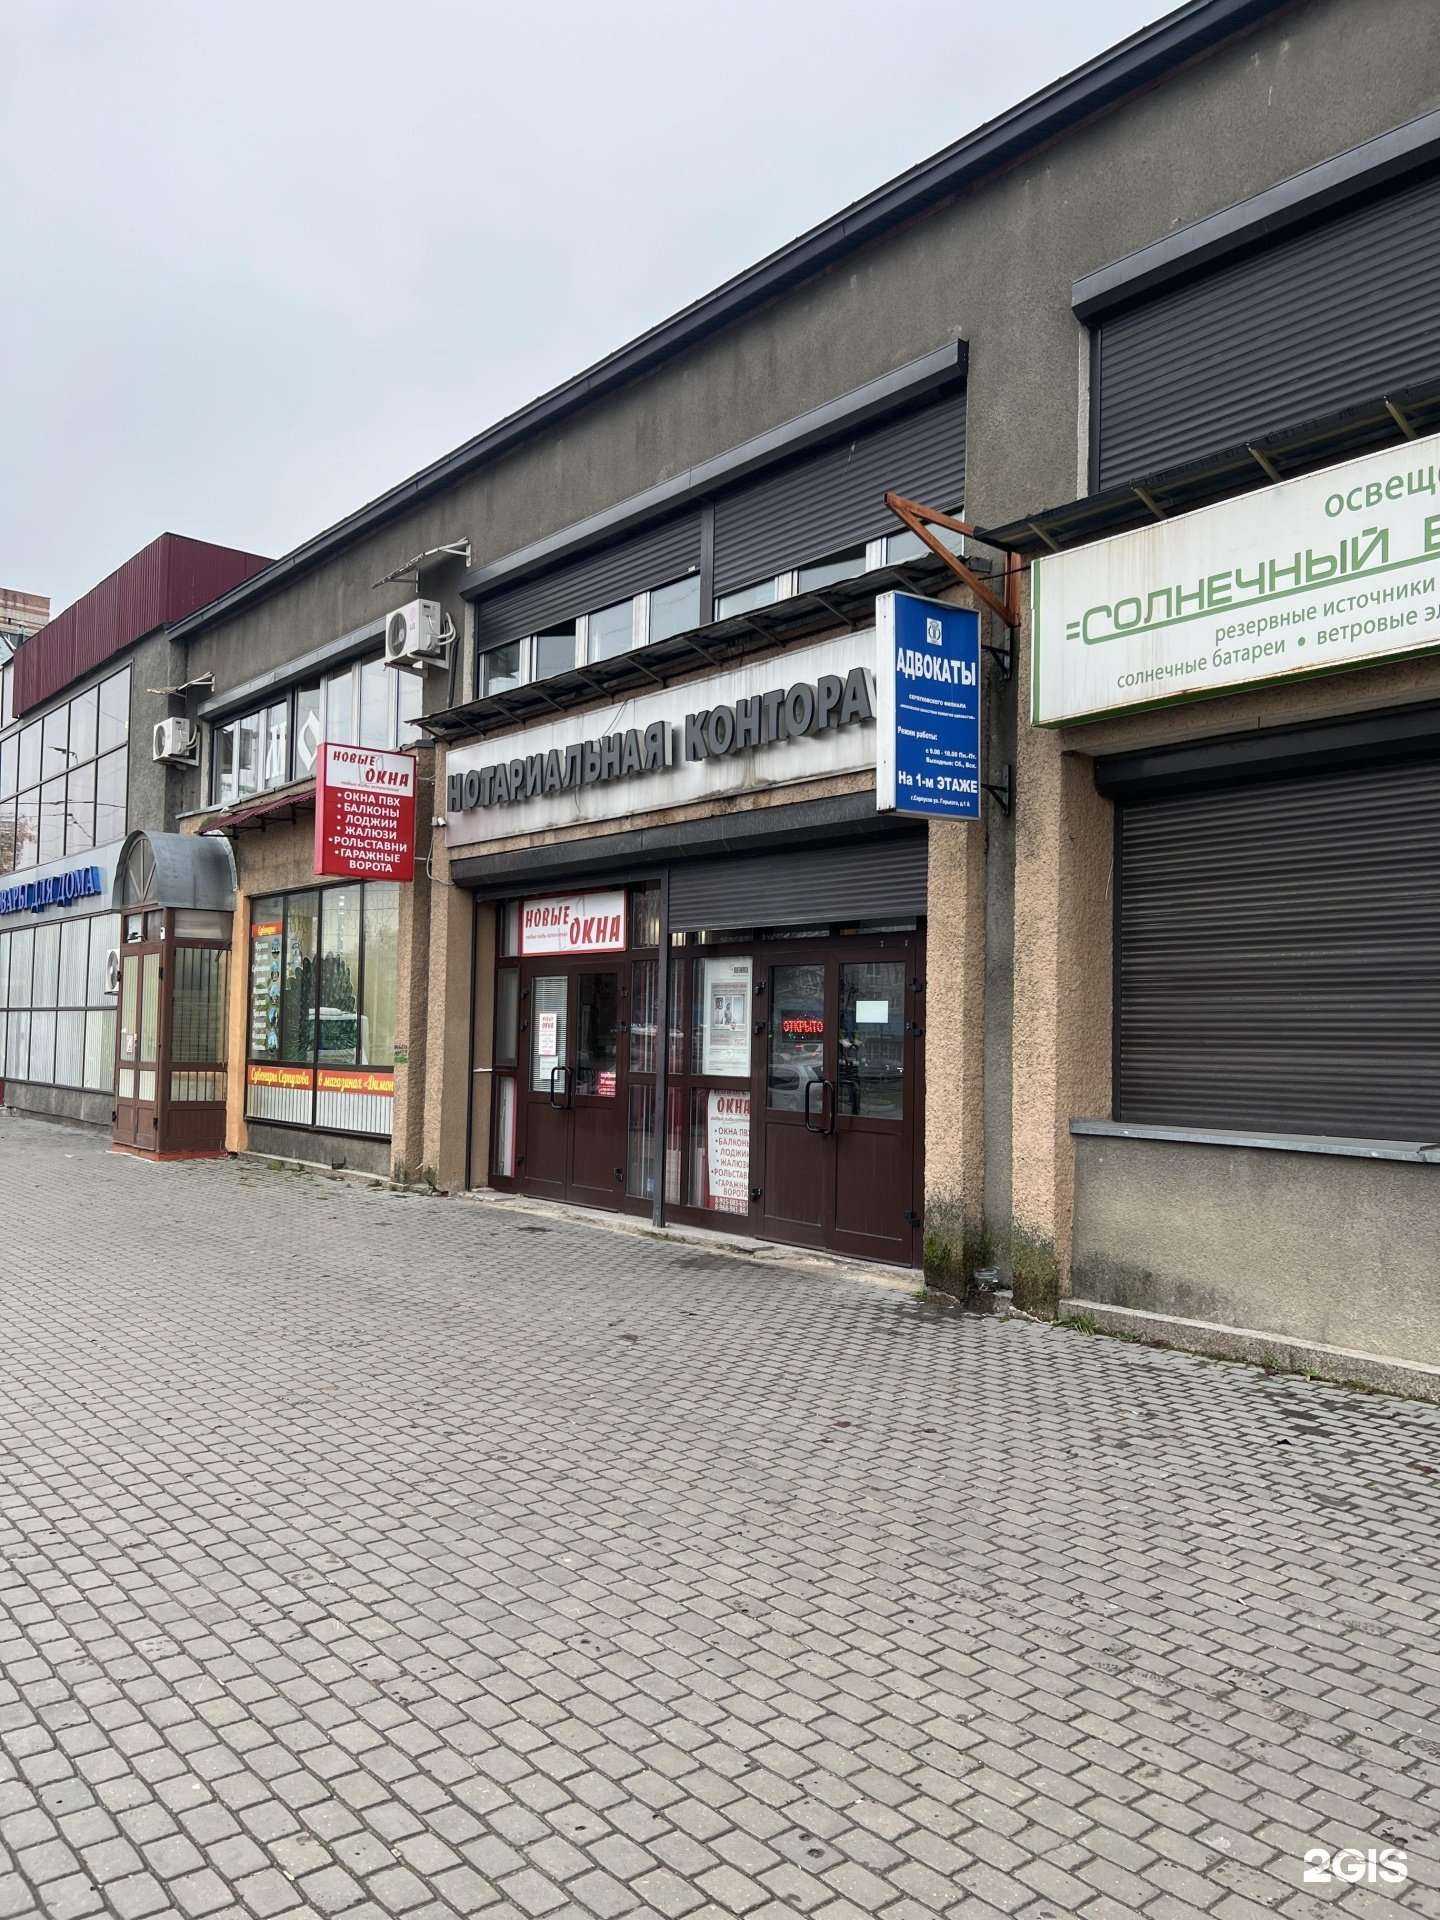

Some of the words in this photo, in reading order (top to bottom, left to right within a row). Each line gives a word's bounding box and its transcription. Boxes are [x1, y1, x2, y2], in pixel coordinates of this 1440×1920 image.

[1324, 465, 1440, 518] освещ
[1083, 526, 1389, 645] СОЛНЕЧНЫЙ
[1215, 604, 1317, 646] резервные
[1323, 577, 1436, 618] источники
[1117, 653, 1207, 689] солнечные
[1212, 639, 1286, 669] батареи
[1317, 606, 1418, 646] ветровые
[897, 647, 976, 686] АДВОКАТЫ
[447, 720, 672, 812] НОТАРИАЛЬНАЯ
[685, 666, 876, 762] КОНТОРА
[897, 725, 916, 737] Режим
[333, 751, 376, 766] НОВЫЕ
[365, 768, 410, 788] ОКНА
[898, 770, 913, 786] На
[916, 773, 934, 789] 1-м
[937, 776, 978, 793] ЭТАЖЕ
[344, 791, 376, 804] ОКНА
[379, 795, 400, 807] ПВХ
[343, 802, 400, 818] БАЛКОНЫ
[345, 815, 397, 829] ЛОДЖИИ
[345, 826, 397, 840] ЖАЛЮЗИ
[334, 836, 408, 853] РОЛЬСТАВНИ
[340, 848, 401, 863] ГАРАЖНЫЕ
[349, 860, 393, 873] ВОРОТА
[32, 878, 54, 908] ДЛЯ
[58, 867, 99, 903] ДОМА
[525, 905, 571, 929] НОВЫЕ
[569, 914, 621, 945] ОКНА
[783, 1020, 824, 1033] ОТКРЫТО
[718, 1126, 738, 1136] ОКНА
[739, 1128, 750, 1137] ПВ
